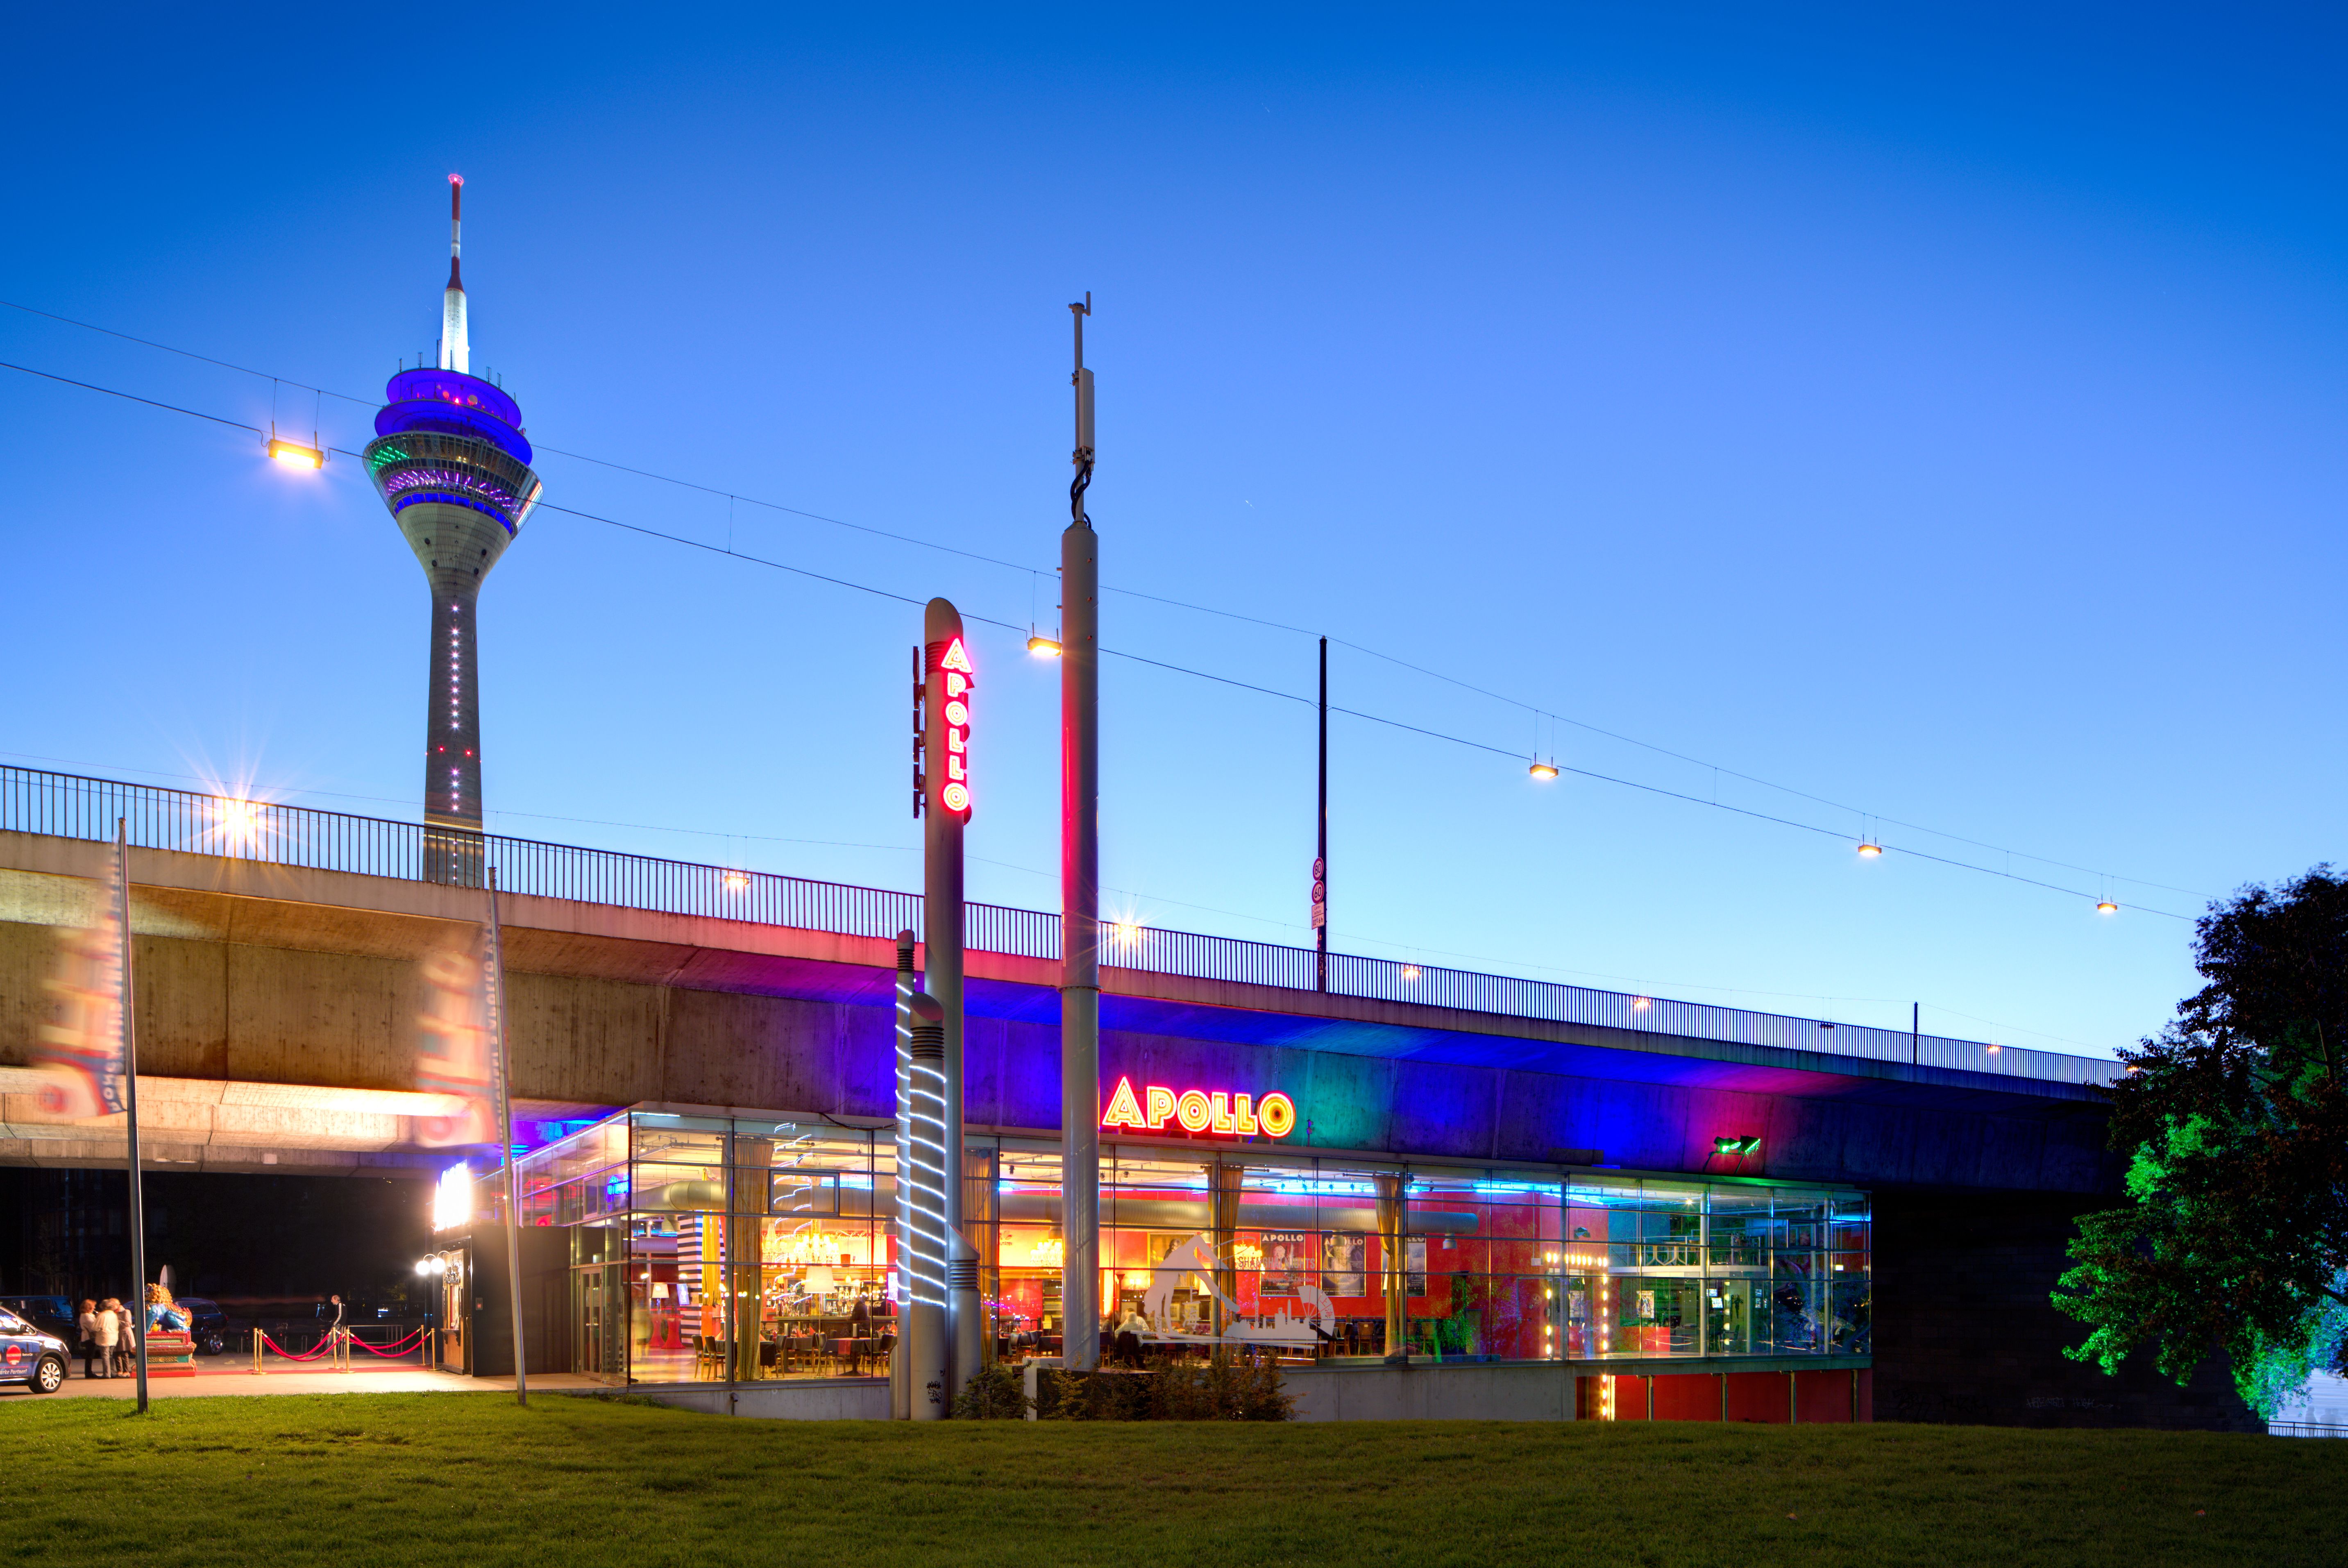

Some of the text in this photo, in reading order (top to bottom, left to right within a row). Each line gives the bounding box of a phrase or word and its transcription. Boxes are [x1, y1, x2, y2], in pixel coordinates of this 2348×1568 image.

[941, 637, 973, 812] APOLLO
[1315, 863, 1321, 875] 80
[1314, 887, 1321, 898] 60
[1102, 1076, 1296, 1137] APOLLO
[1324, 1237, 1363, 1246] ALLO
[1238, 1256, 1315, 1269] SHANGHAI NIGHTS
